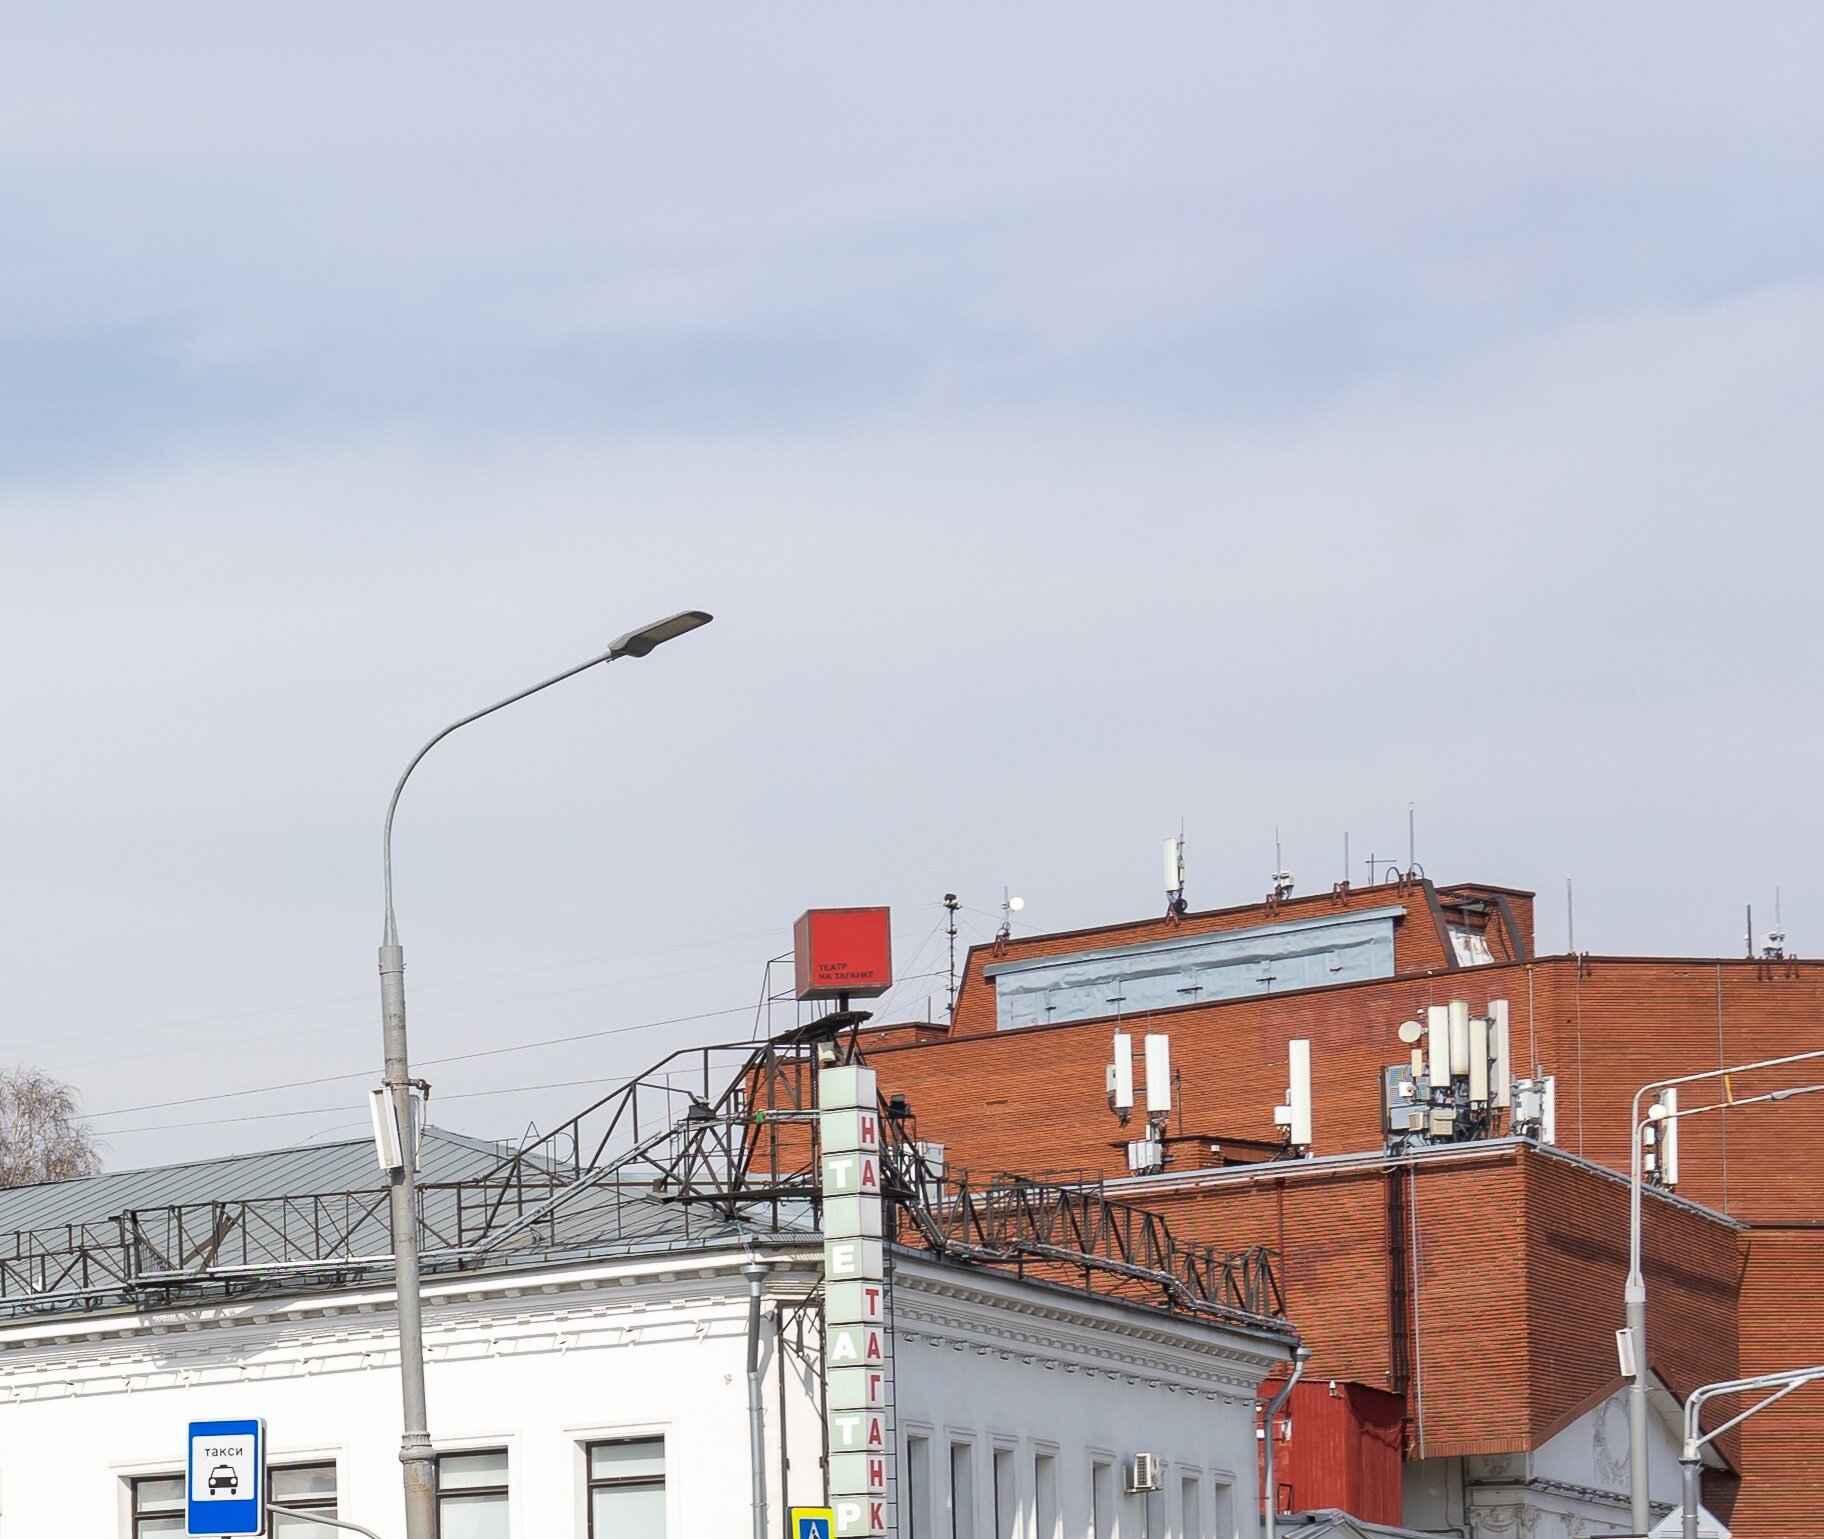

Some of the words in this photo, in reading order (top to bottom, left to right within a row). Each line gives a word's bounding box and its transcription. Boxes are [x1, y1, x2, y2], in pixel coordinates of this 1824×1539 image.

[820, 963, 847, 971] ТЕАТР
[835, 971, 874, 979] ТАГАНКЕ
[828, 1160, 861, 1531] ТЕАТР
[204, 1447, 244, 1457] такси
